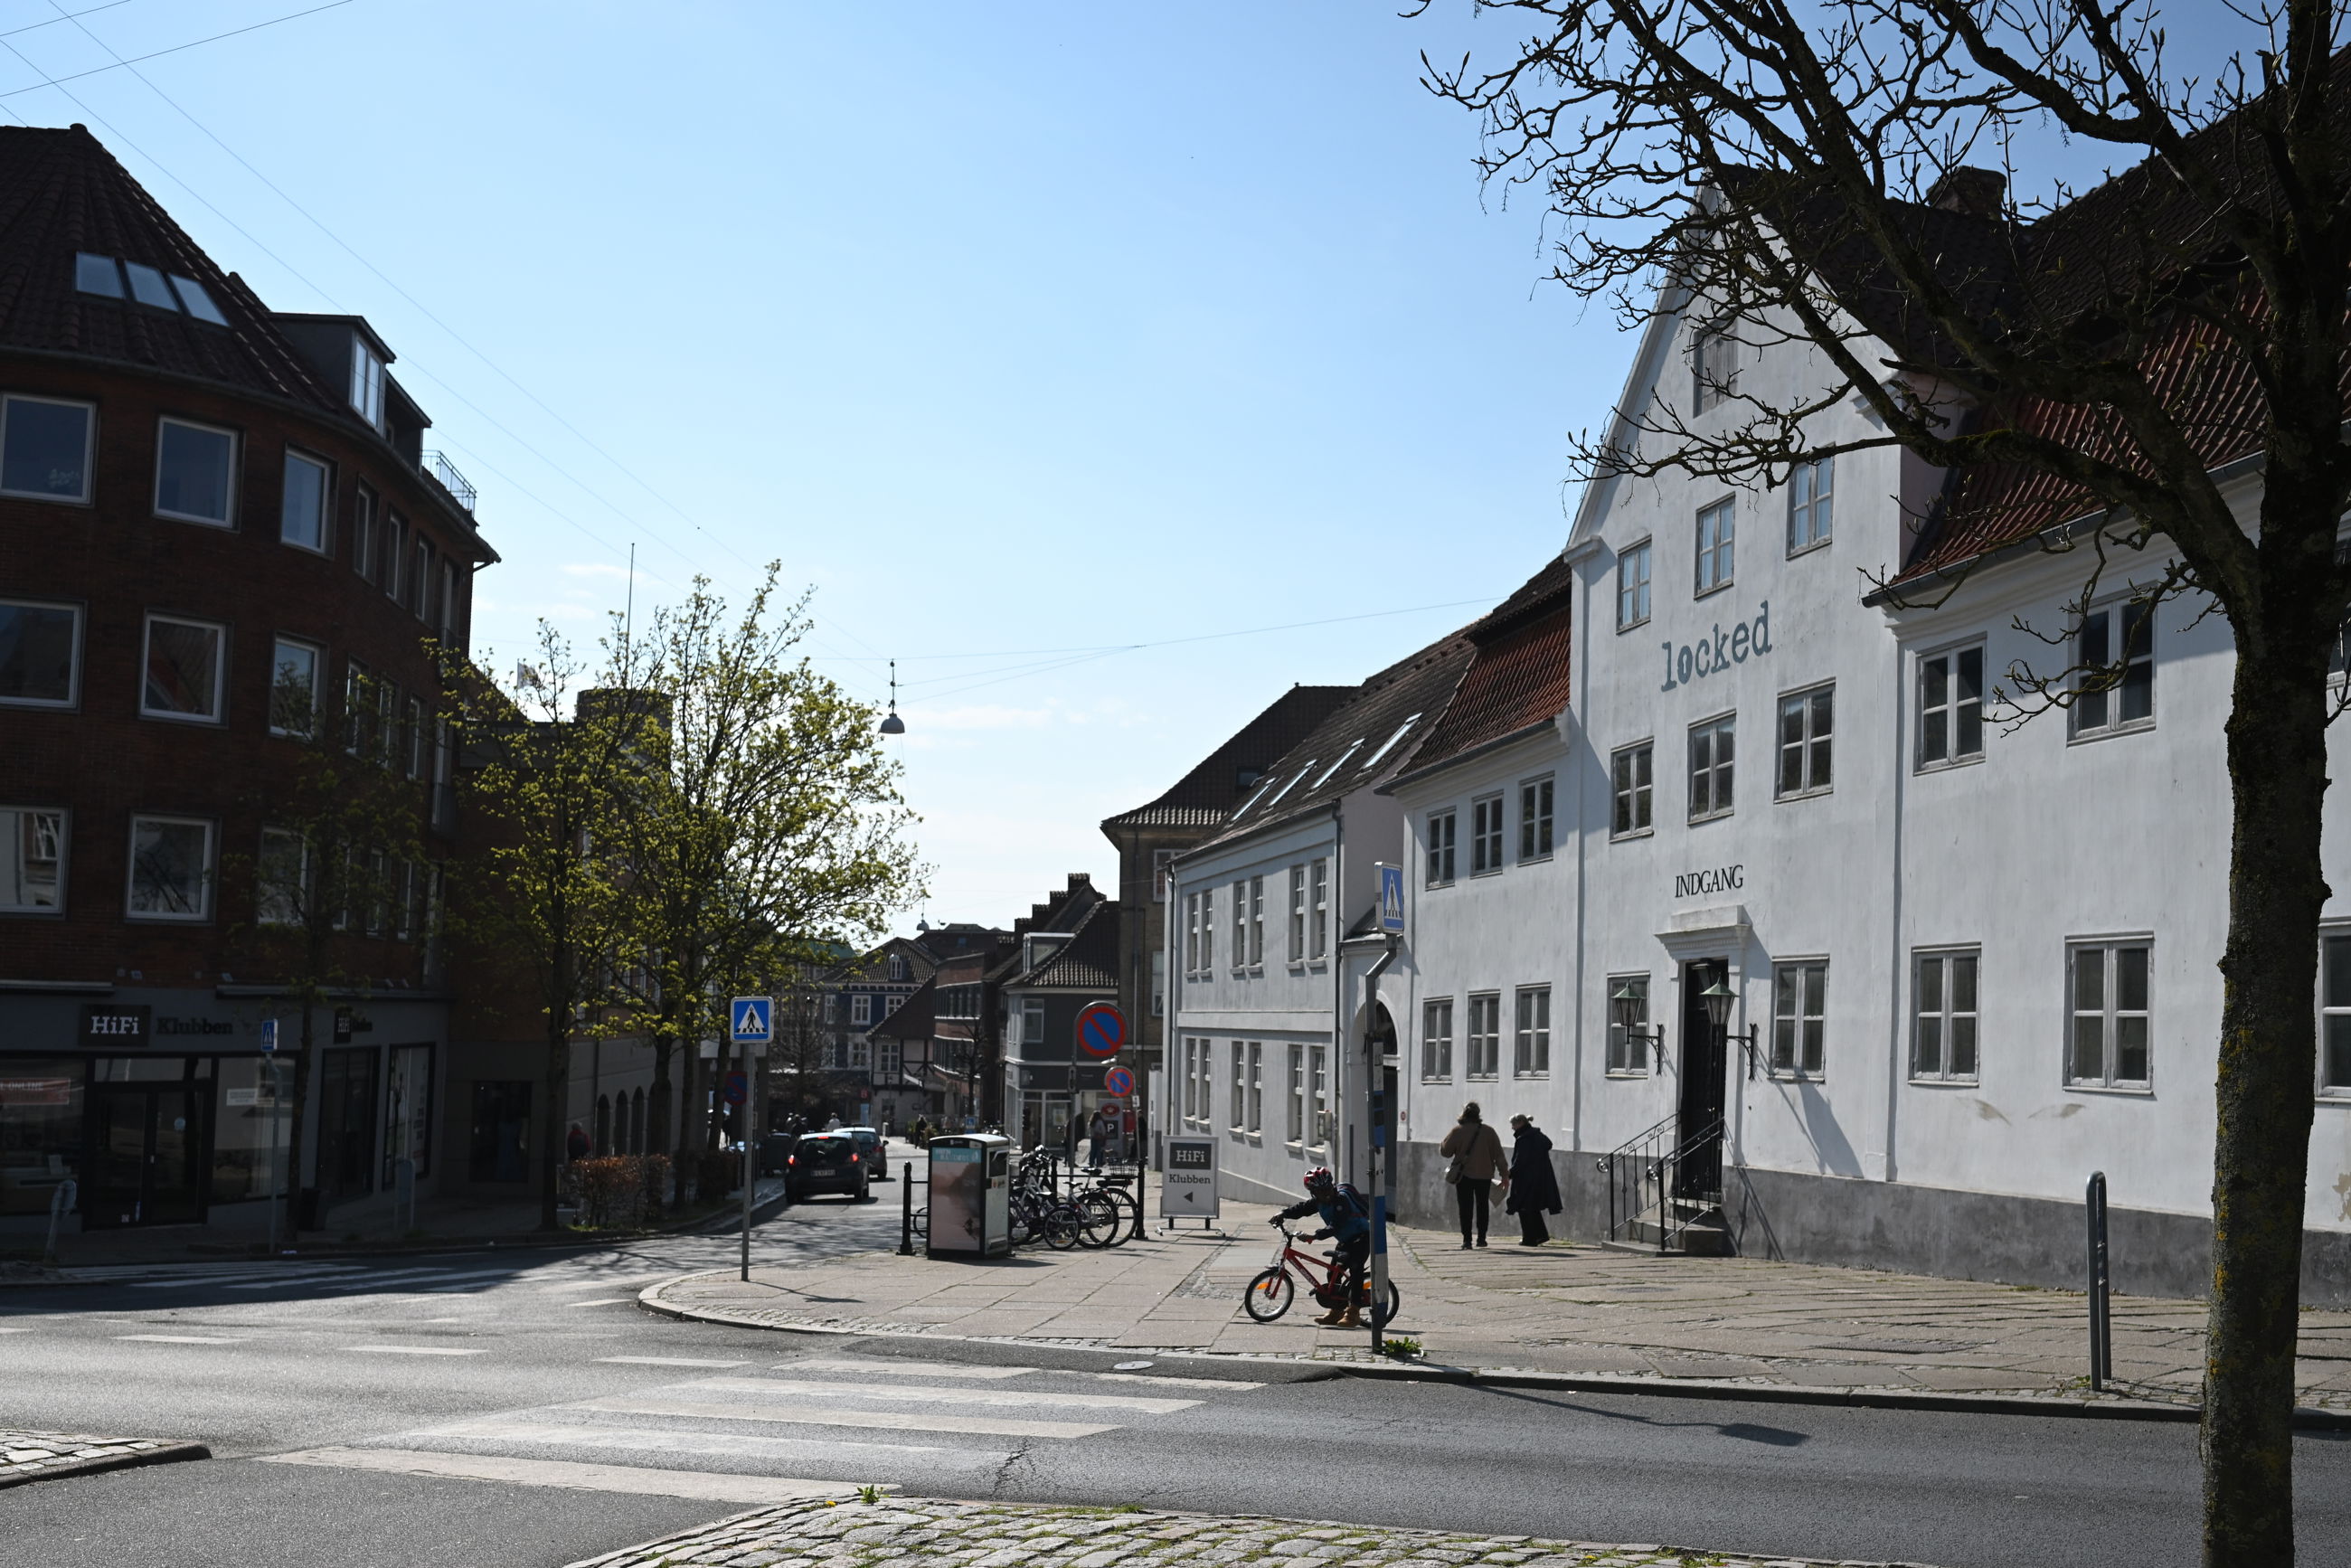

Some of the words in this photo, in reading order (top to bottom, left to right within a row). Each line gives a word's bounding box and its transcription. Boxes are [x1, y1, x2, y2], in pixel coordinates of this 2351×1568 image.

[1661, 600, 1772, 692] locked
[1675, 864, 1743, 898] INDGANG
[90, 1015, 139, 1034] HiFi
[156, 1017, 232, 1034] Klubben
[1107, 1123, 1114, 1132] P
[1176, 1150, 1205, 1163] HiFi
[1169, 1174, 1211, 1185] Klubben
